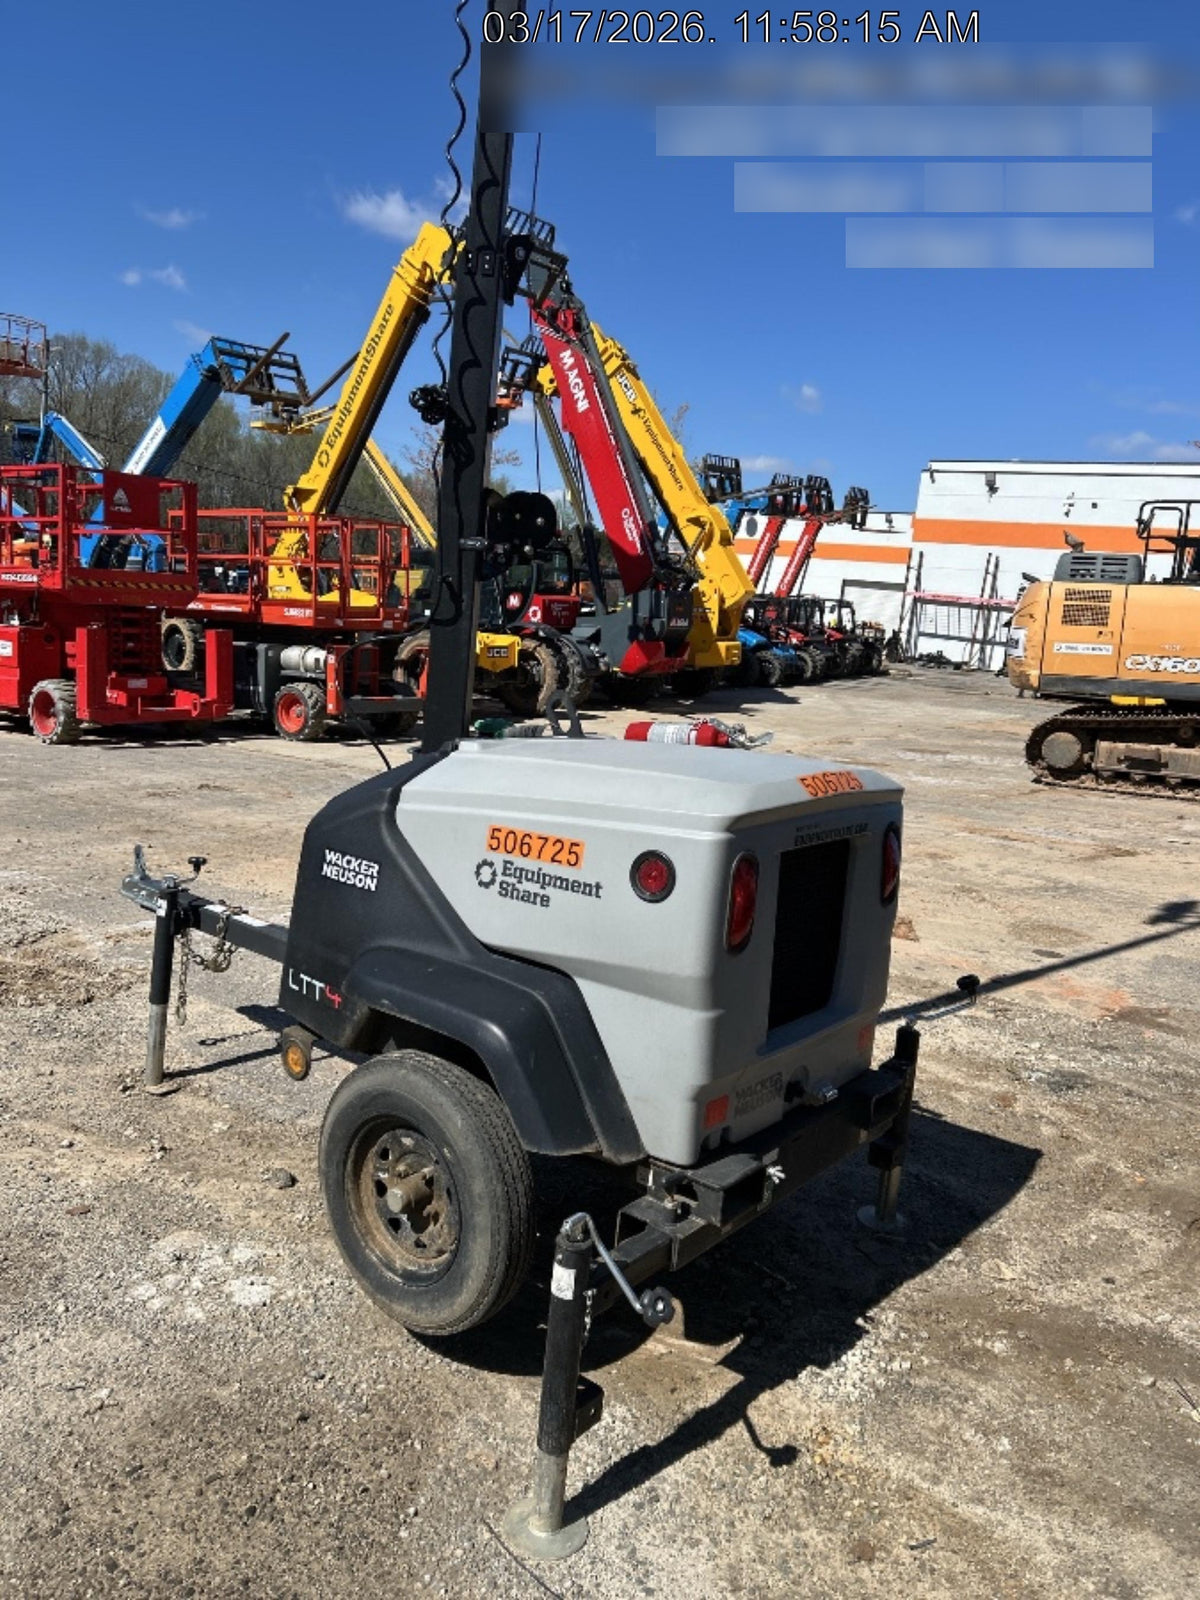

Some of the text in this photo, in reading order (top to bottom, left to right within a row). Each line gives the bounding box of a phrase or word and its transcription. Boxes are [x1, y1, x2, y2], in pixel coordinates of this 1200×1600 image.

[559, 348, 590, 414] MAGNI
[616, 370, 638, 404] JCB
[799, 771, 864, 797] 506725
[324, 849, 380, 877] WACKER
[488, 827, 581, 867] 506725
[321, 863, 378, 892] NEUSON
[498, 880, 551, 908] Share
[501, 859, 604, 900] Equipment
[289, 968, 342, 1009] LTT4
